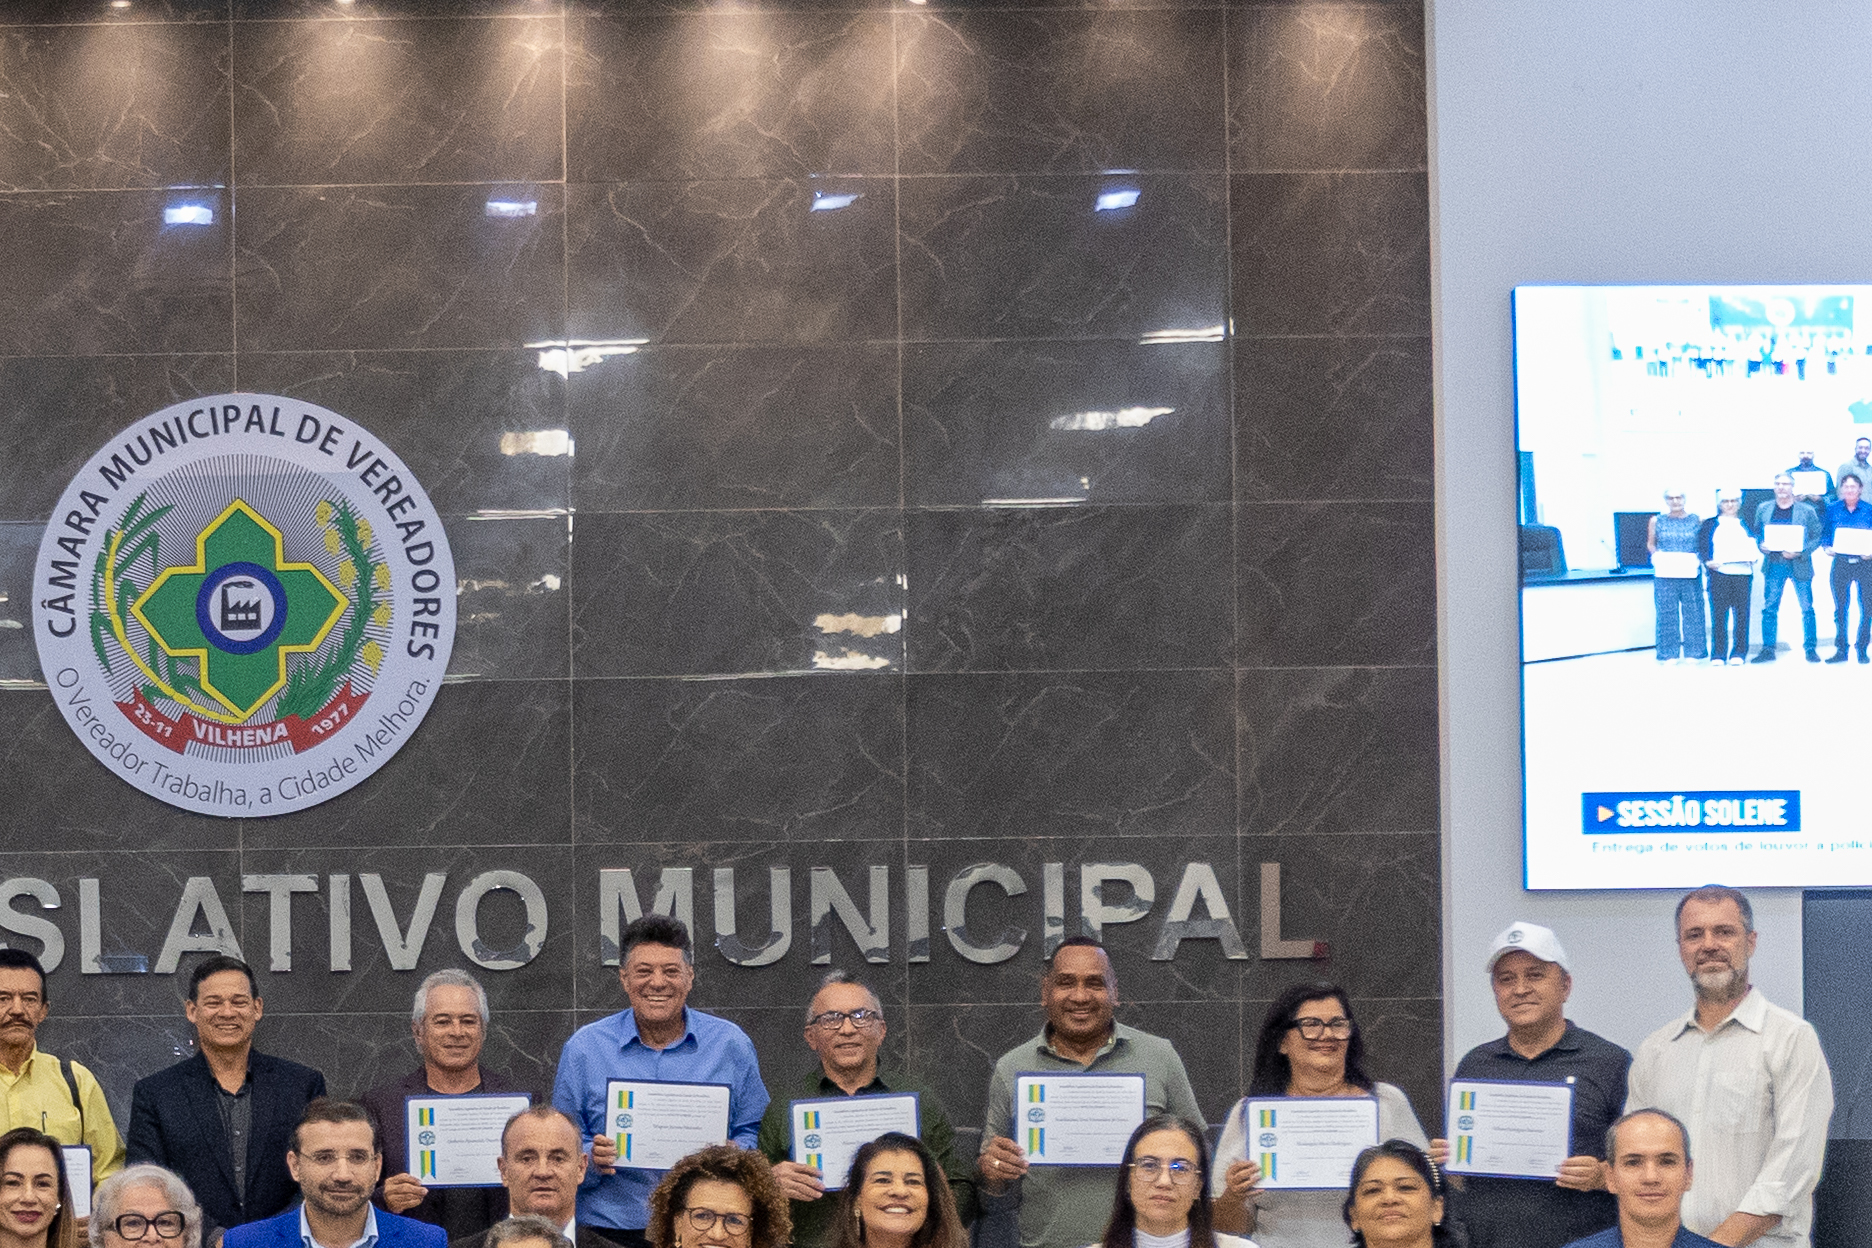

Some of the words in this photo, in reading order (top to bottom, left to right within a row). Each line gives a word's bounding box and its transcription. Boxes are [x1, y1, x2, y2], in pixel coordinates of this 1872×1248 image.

[41, 495, 107, 639] CÂMARA
[99, 404, 286, 490] MUNICIPAL
[296, 413, 344, 456] DE
[345, 440, 441, 661] VEREADORES
[56, 666, 80, 689] O
[66, 693, 149, 777] Vereador
[133, 703, 174, 739] 23-11
[192, 720, 289, 748] VILHENA
[310, 702, 351, 737] 1977
[149, 762, 254, 811] Trabalha,
[259, 788, 273, 805] a
[278, 757, 358, 802] Cidade
[1617, 795, 1701, 828] SESSÃO
[1704, 798, 1788, 826] SOLENE
[599, 861, 1329, 968] MUNICIPAL
